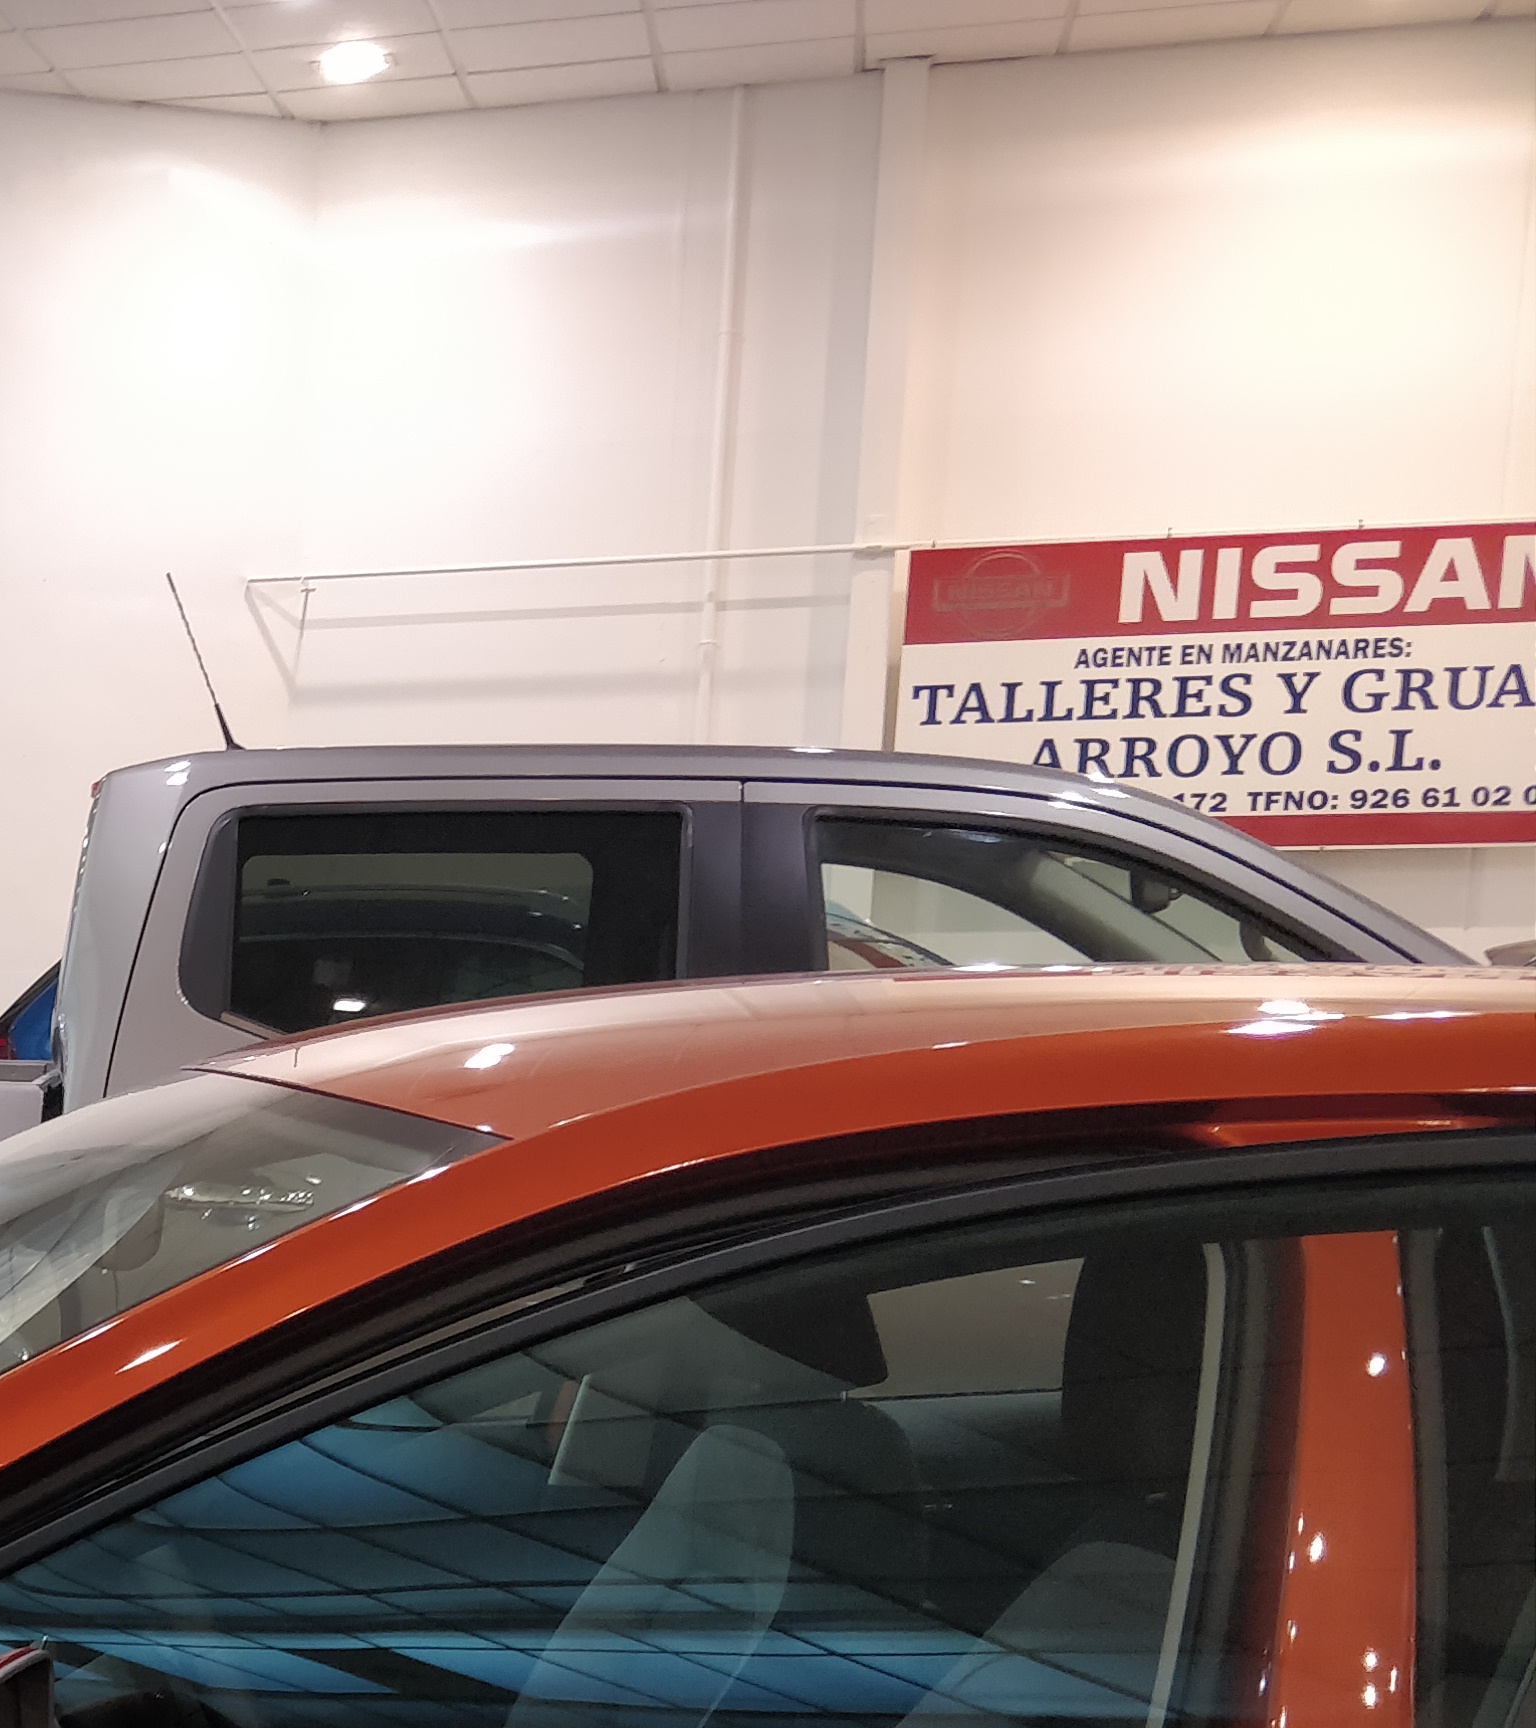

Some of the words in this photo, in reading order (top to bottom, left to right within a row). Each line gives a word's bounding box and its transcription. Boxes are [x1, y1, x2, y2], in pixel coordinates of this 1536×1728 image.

[1073, 645, 1172, 670] AGENTE
[1179, 641, 1213, 666] EN
[1220, 636, 1413, 664] MANZANARES:
[911, 672, 1253, 726] TALLERES
[1276, 671, 1322, 714] Y
[1031, 729, 1303, 780] ARROYO
[1326, 728, 1442, 775] S.L.
[1247, 789, 1339, 812] TFNO:
[1349, 787, 1410, 809] 926
[1421, 786, 1461, 808] 61
[1471, 785, 1512, 806] 02
